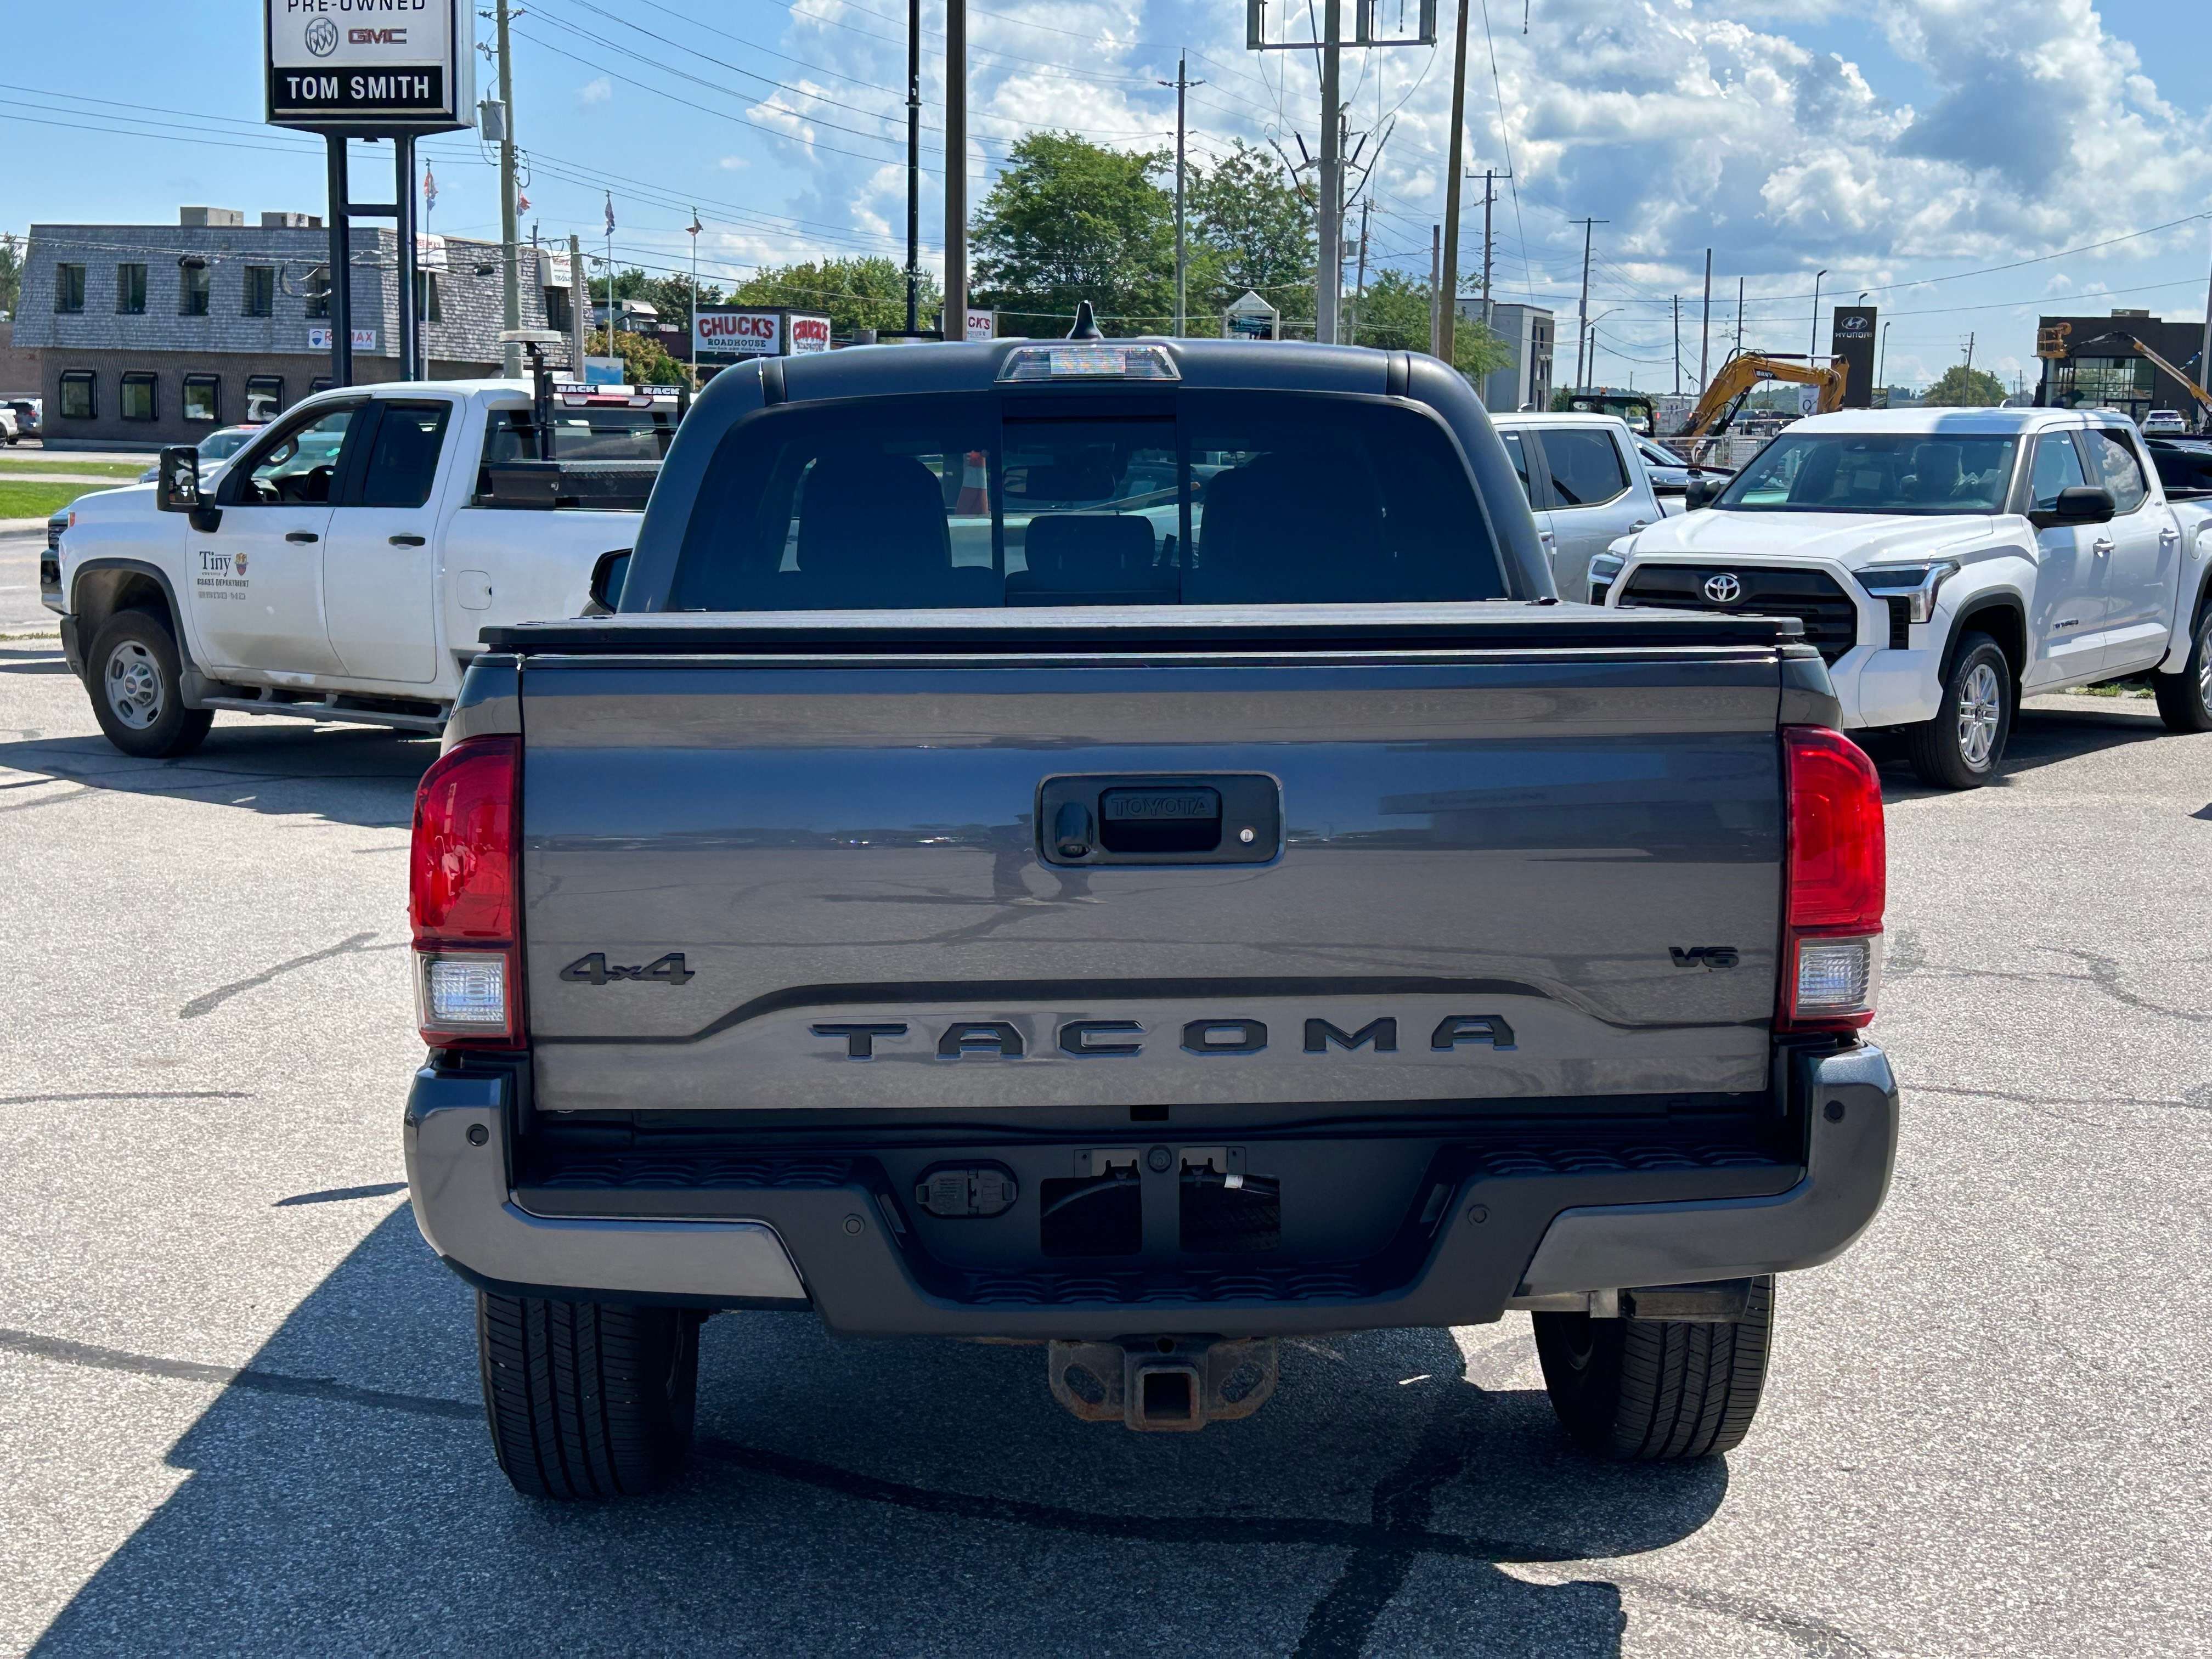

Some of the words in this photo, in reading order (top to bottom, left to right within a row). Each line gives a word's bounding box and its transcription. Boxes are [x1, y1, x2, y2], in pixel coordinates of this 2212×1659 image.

[287, 0, 425, 12] PRE-OWNED
[348, 28, 407, 44] GMC
[287, 77, 338, 99] TOM
[351, 76, 429, 99] SMITH
[698, 316, 774, 339] CHUCK'S
[708, 338, 766, 347] ROADHOUSE
[643, 387, 680, 395] RACK
[199, 551, 232, 577] Tiny
[1111, 797, 1210, 817] TOYOTA
[1669, 947, 1739, 968] V6
[560, 952, 695, 985] 4x4
[809, 1014, 1519, 1061] TACOMA
